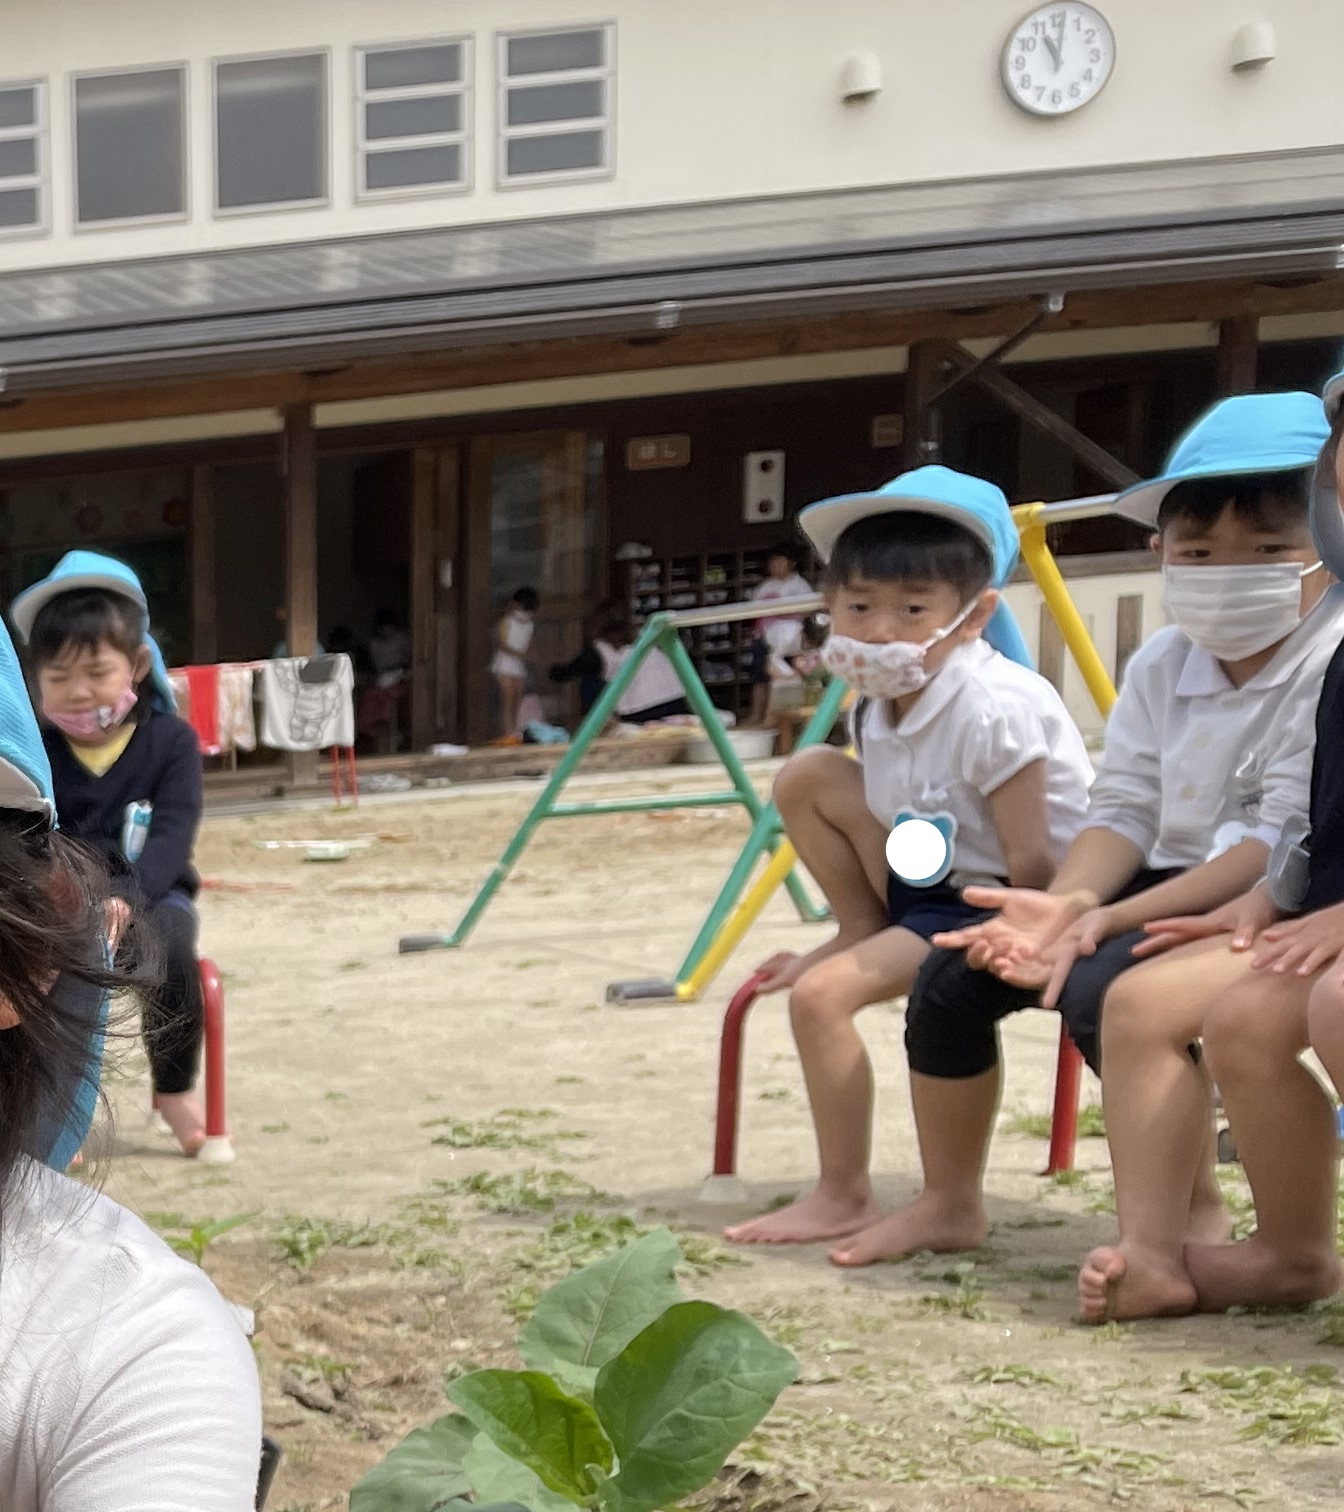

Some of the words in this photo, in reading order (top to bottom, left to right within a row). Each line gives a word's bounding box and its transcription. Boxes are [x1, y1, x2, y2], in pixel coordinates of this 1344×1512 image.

[1033, 20, 1047, 35] 11
[1074, 17, 1081, 32] 1
[1085, 28, 1096, 44] 2
[1018, 37, 1036, 52] 10
[1090, 48, 1101, 63] 3
[1014, 56, 1026, 71] 9
[1020, 75, 1031, 89] 8
[1083, 68, 1093, 82] 4
[1035, 86, 1046, 101] 7
[1051, 90, 1062, 105] 6
[1069, 83, 1081, 98] 5
